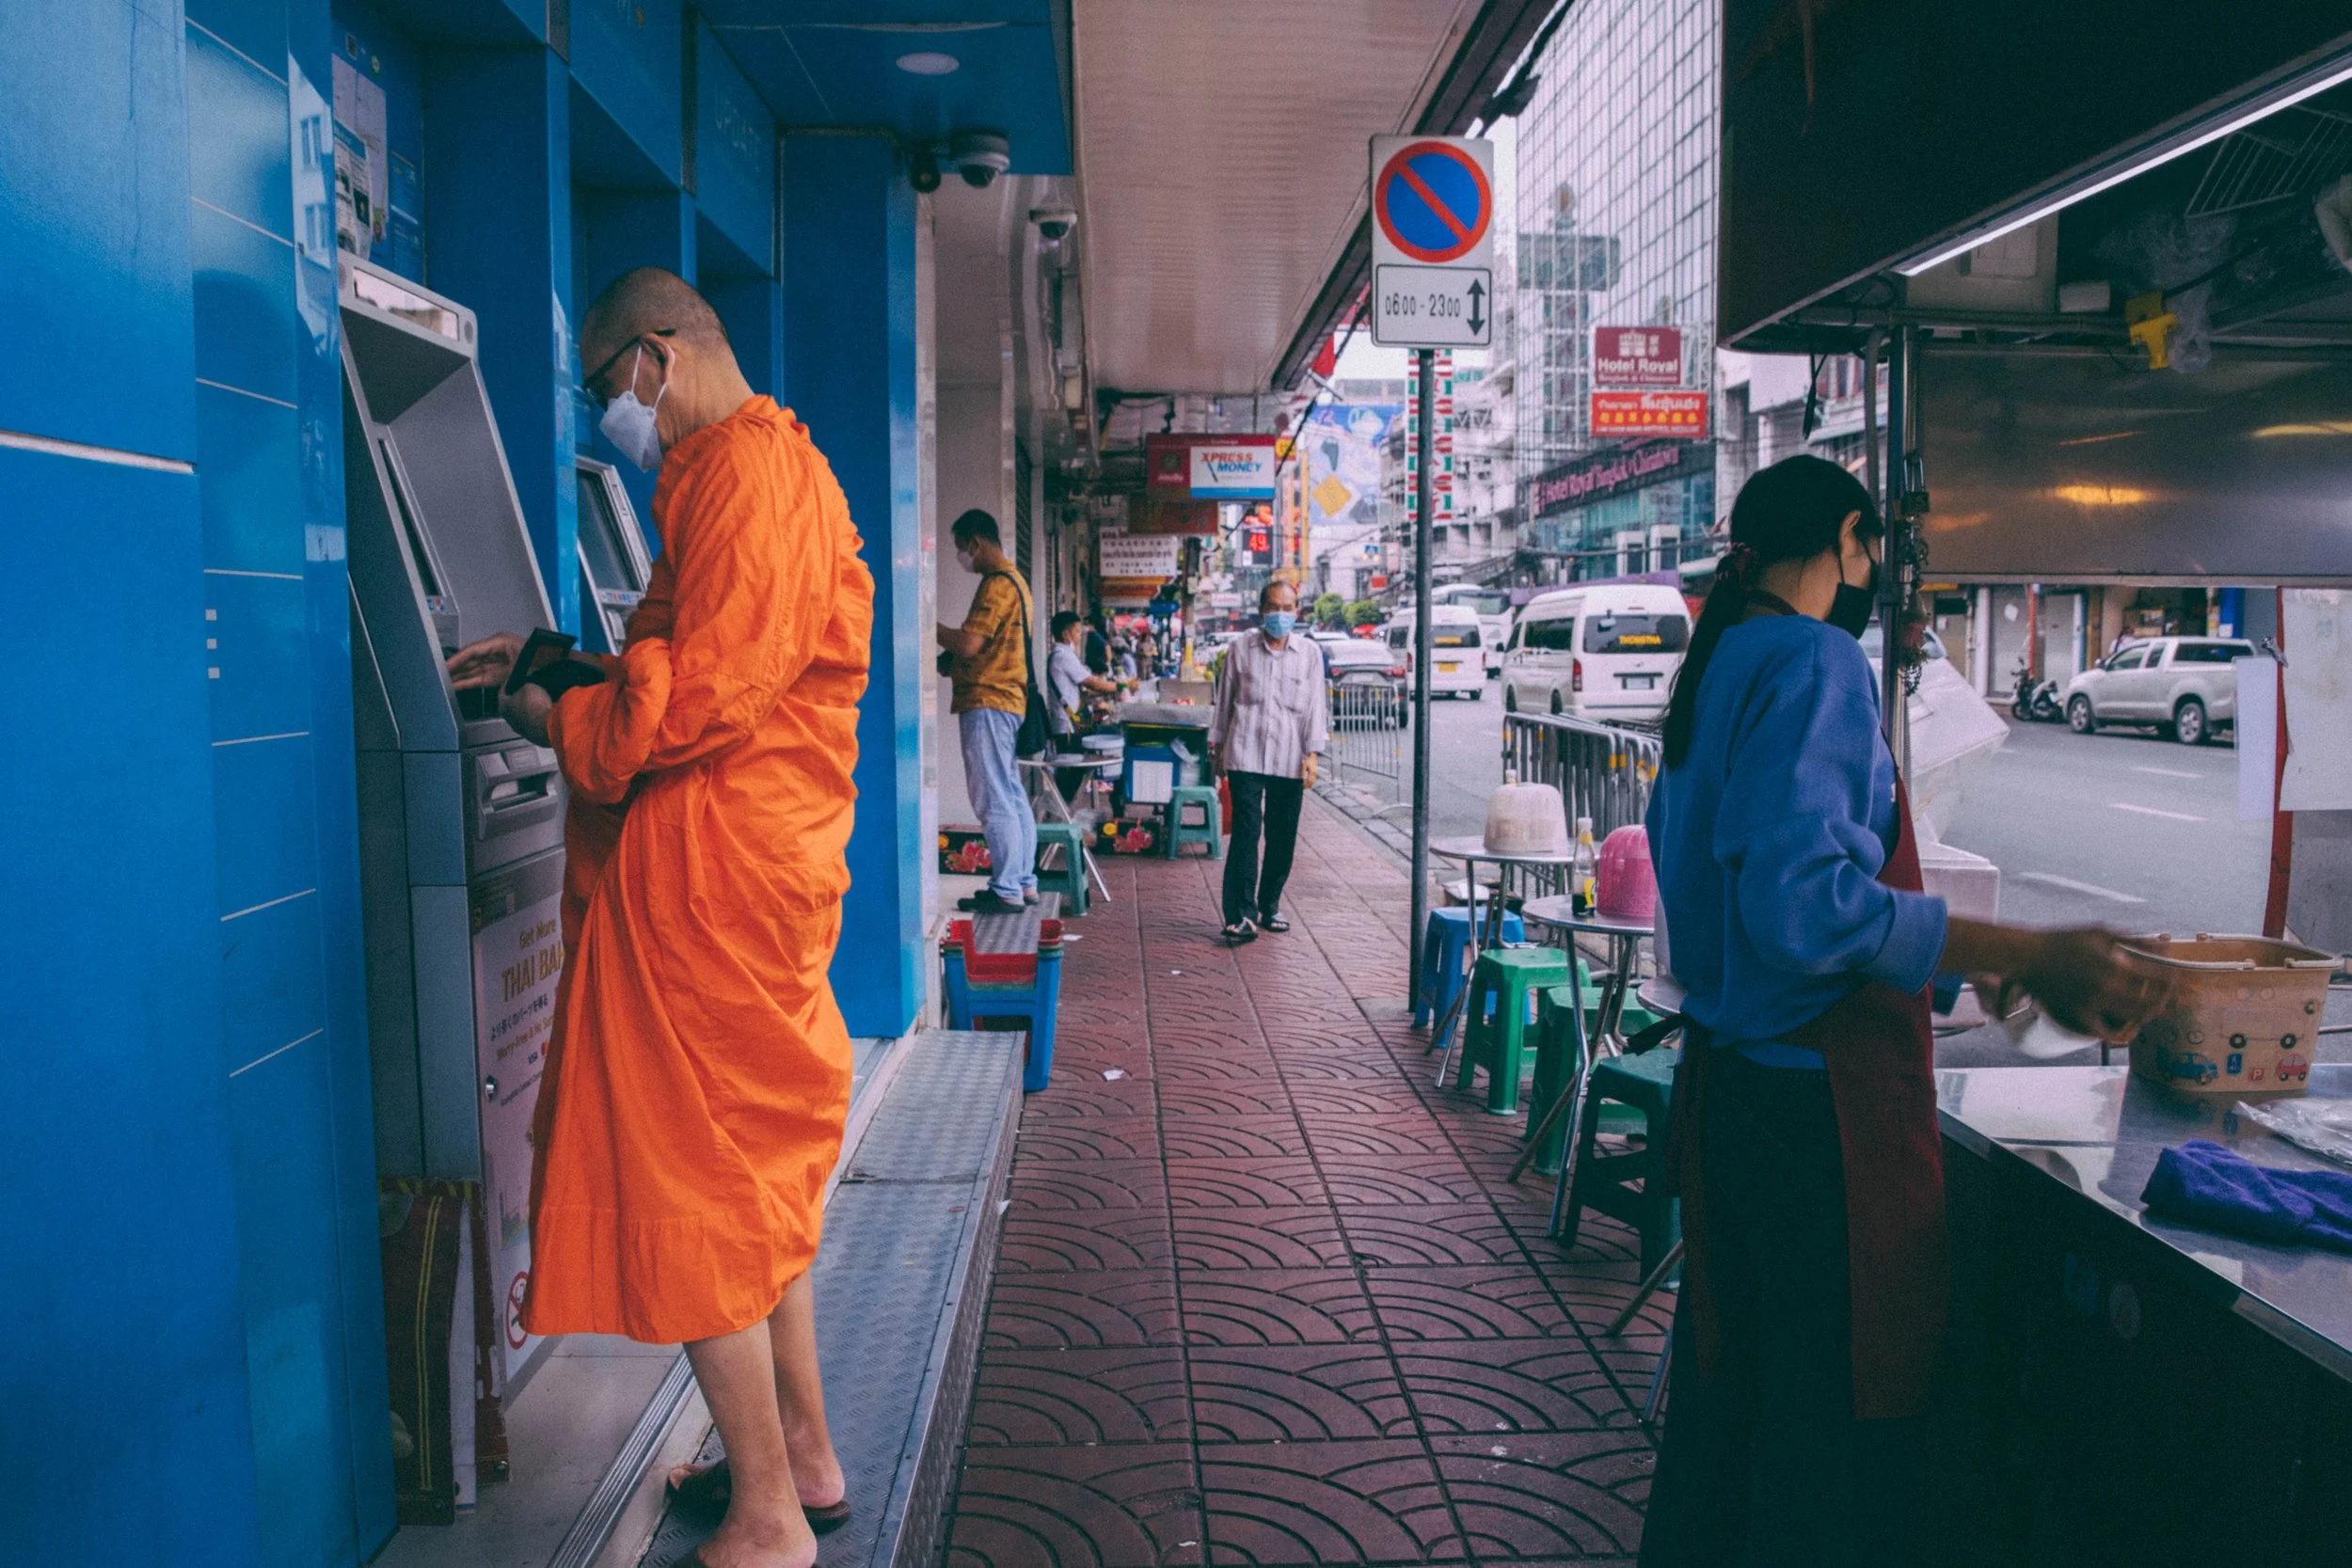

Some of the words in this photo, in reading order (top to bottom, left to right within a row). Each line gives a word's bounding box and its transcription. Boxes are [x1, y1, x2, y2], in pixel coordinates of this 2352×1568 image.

[1597, 357, 1635, 373] Hotel
[1638, 358, 1679, 374] Royal
[1200, 451, 1254, 463] XPRESS
[1216, 462, 1262, 473] MONEY
[519, 927, 534, 950] Get
[501, 954, 535, 1002] THAI
[2253, 1069, 2263, 1080] P
